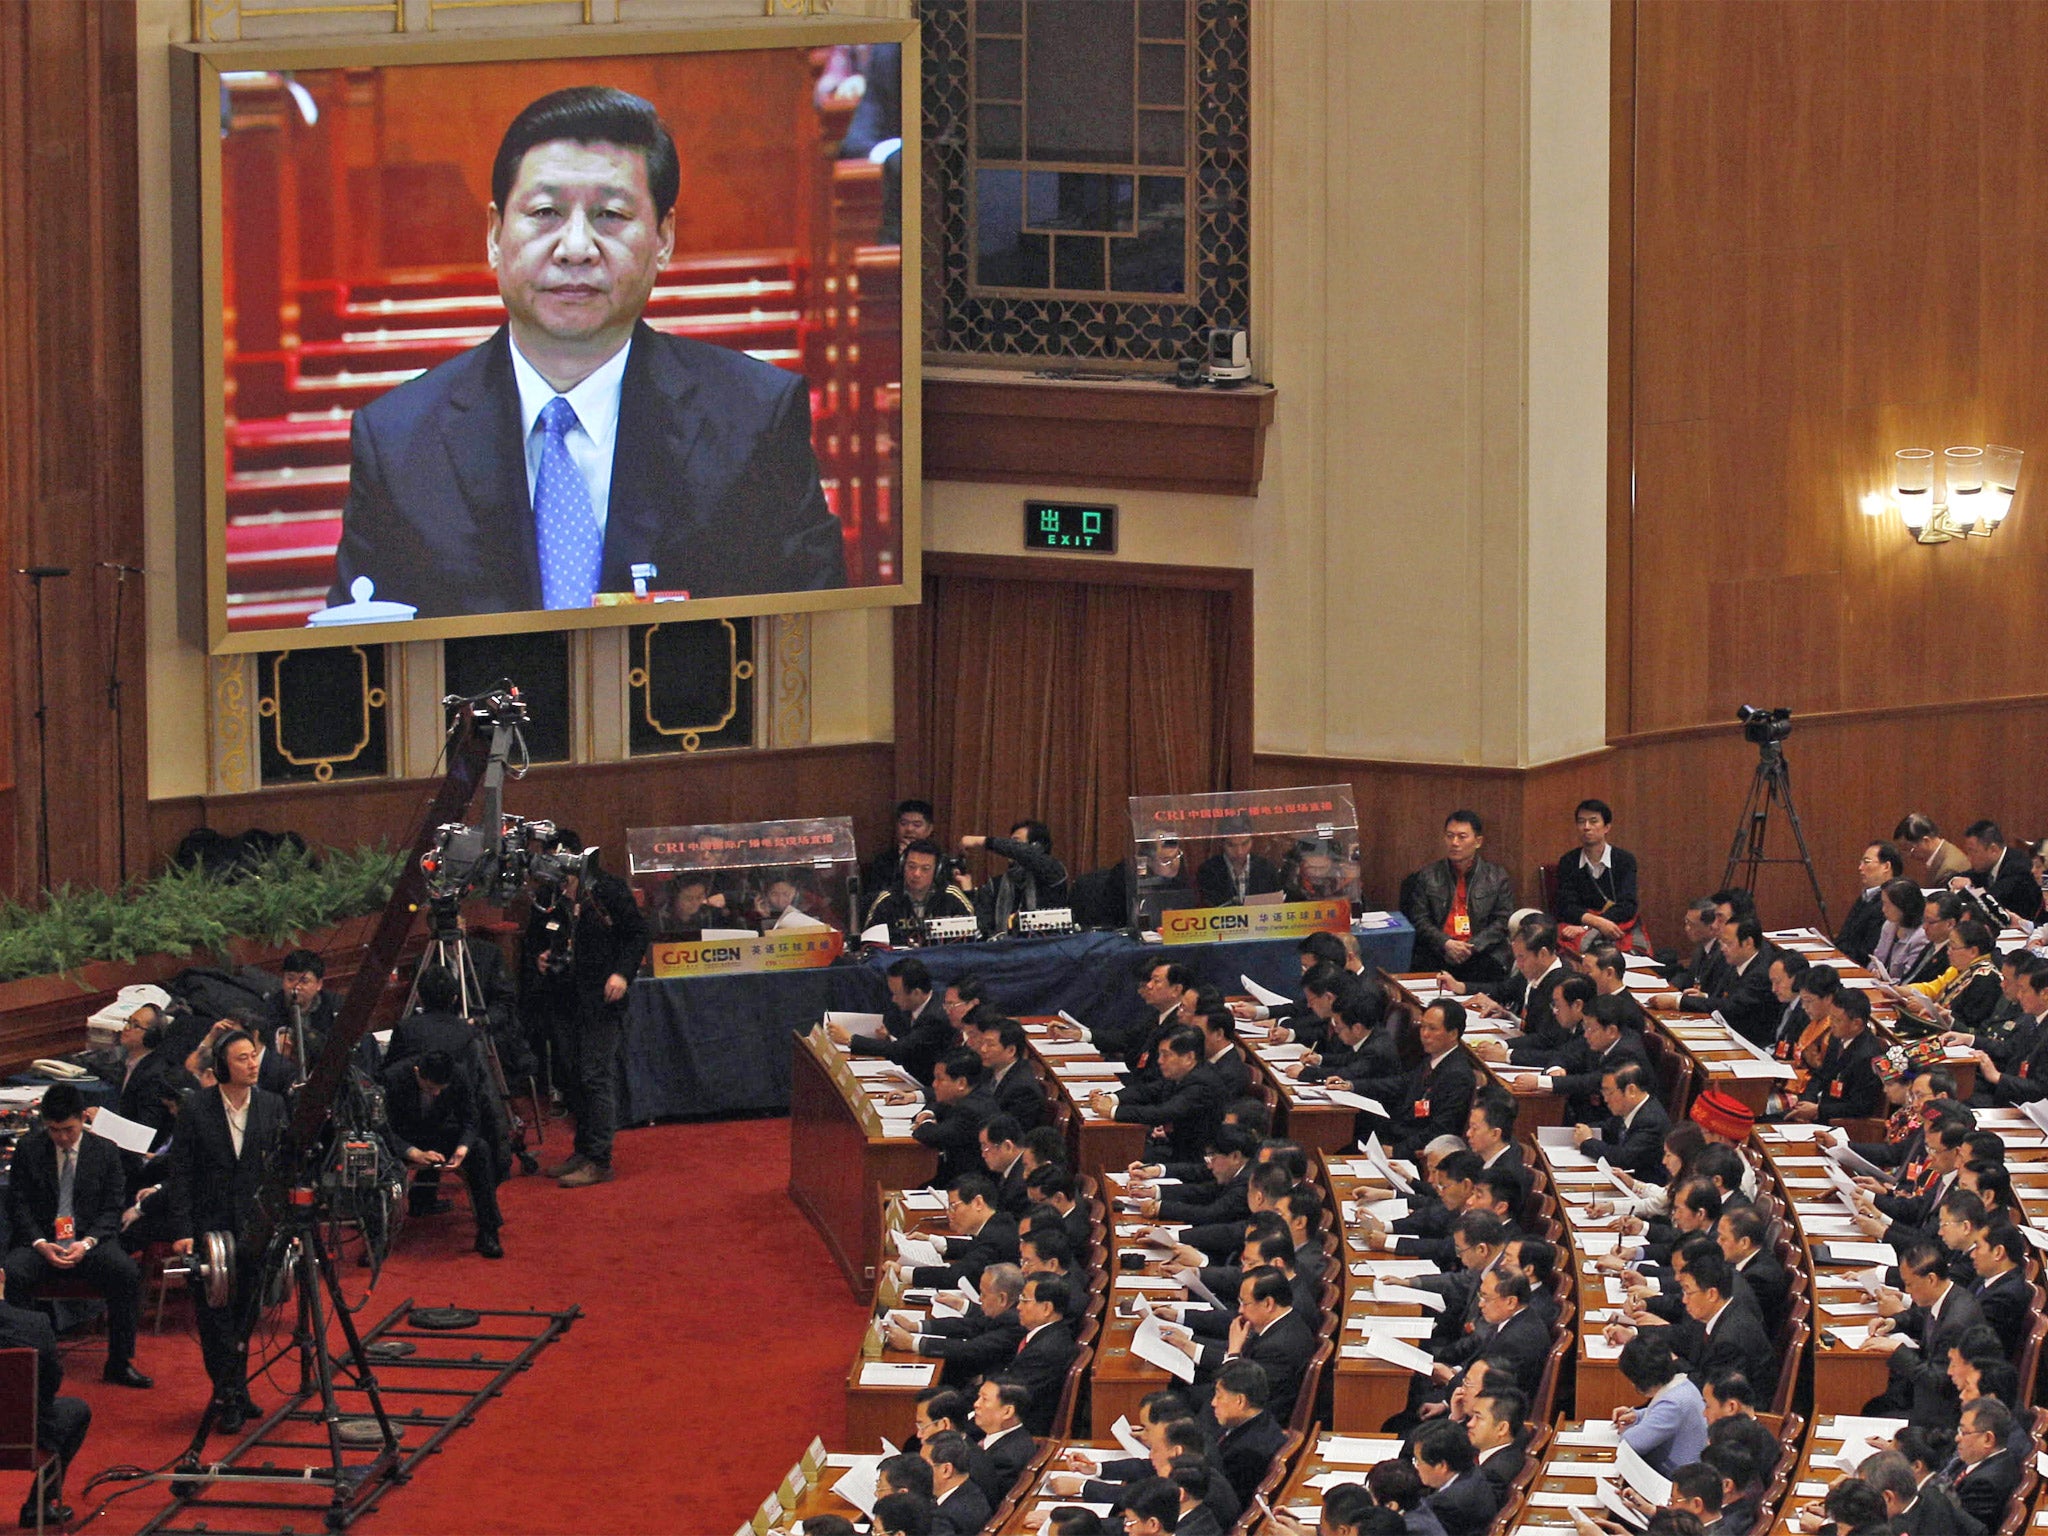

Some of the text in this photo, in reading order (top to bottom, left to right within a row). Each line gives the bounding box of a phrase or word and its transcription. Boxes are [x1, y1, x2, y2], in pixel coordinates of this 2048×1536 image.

[1040, 509, 1101, 534] 出口
[1048, 534, 1093, 546] EXIT
[1154, 809, 1185, 821] CRI
[653, 841, 685, 854] CRI
[1209, 914, 1249, 930] CIBN
[701, 947, 741, 963] CIBN
